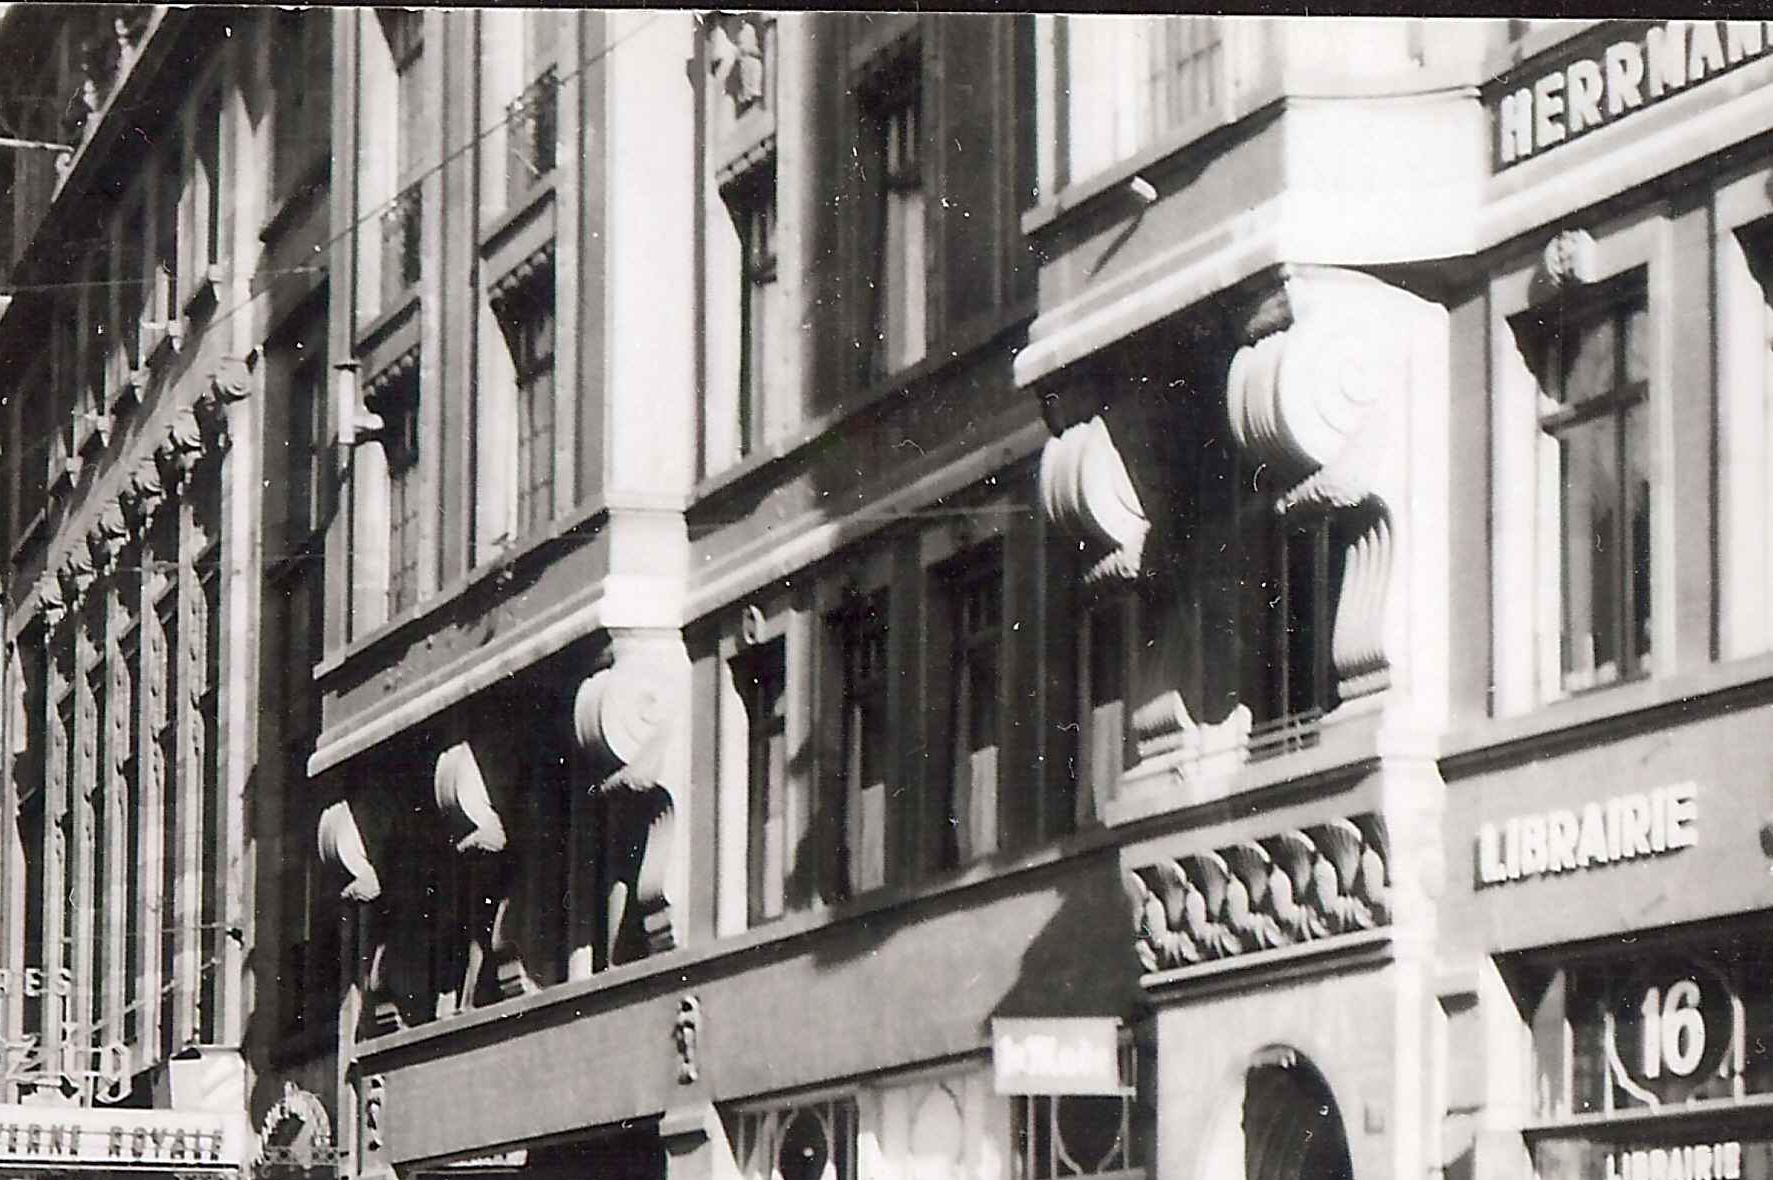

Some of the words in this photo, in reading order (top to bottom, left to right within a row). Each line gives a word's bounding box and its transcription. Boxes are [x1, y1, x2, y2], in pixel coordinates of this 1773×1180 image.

[1500, 20, 1773, 163] HERRMAN
[1479, 781, 1699, 884] LIBRAIRIE
[1640, 978, 1706, 1080] 16
[107, 1125, 224, 1162] ROYALE
